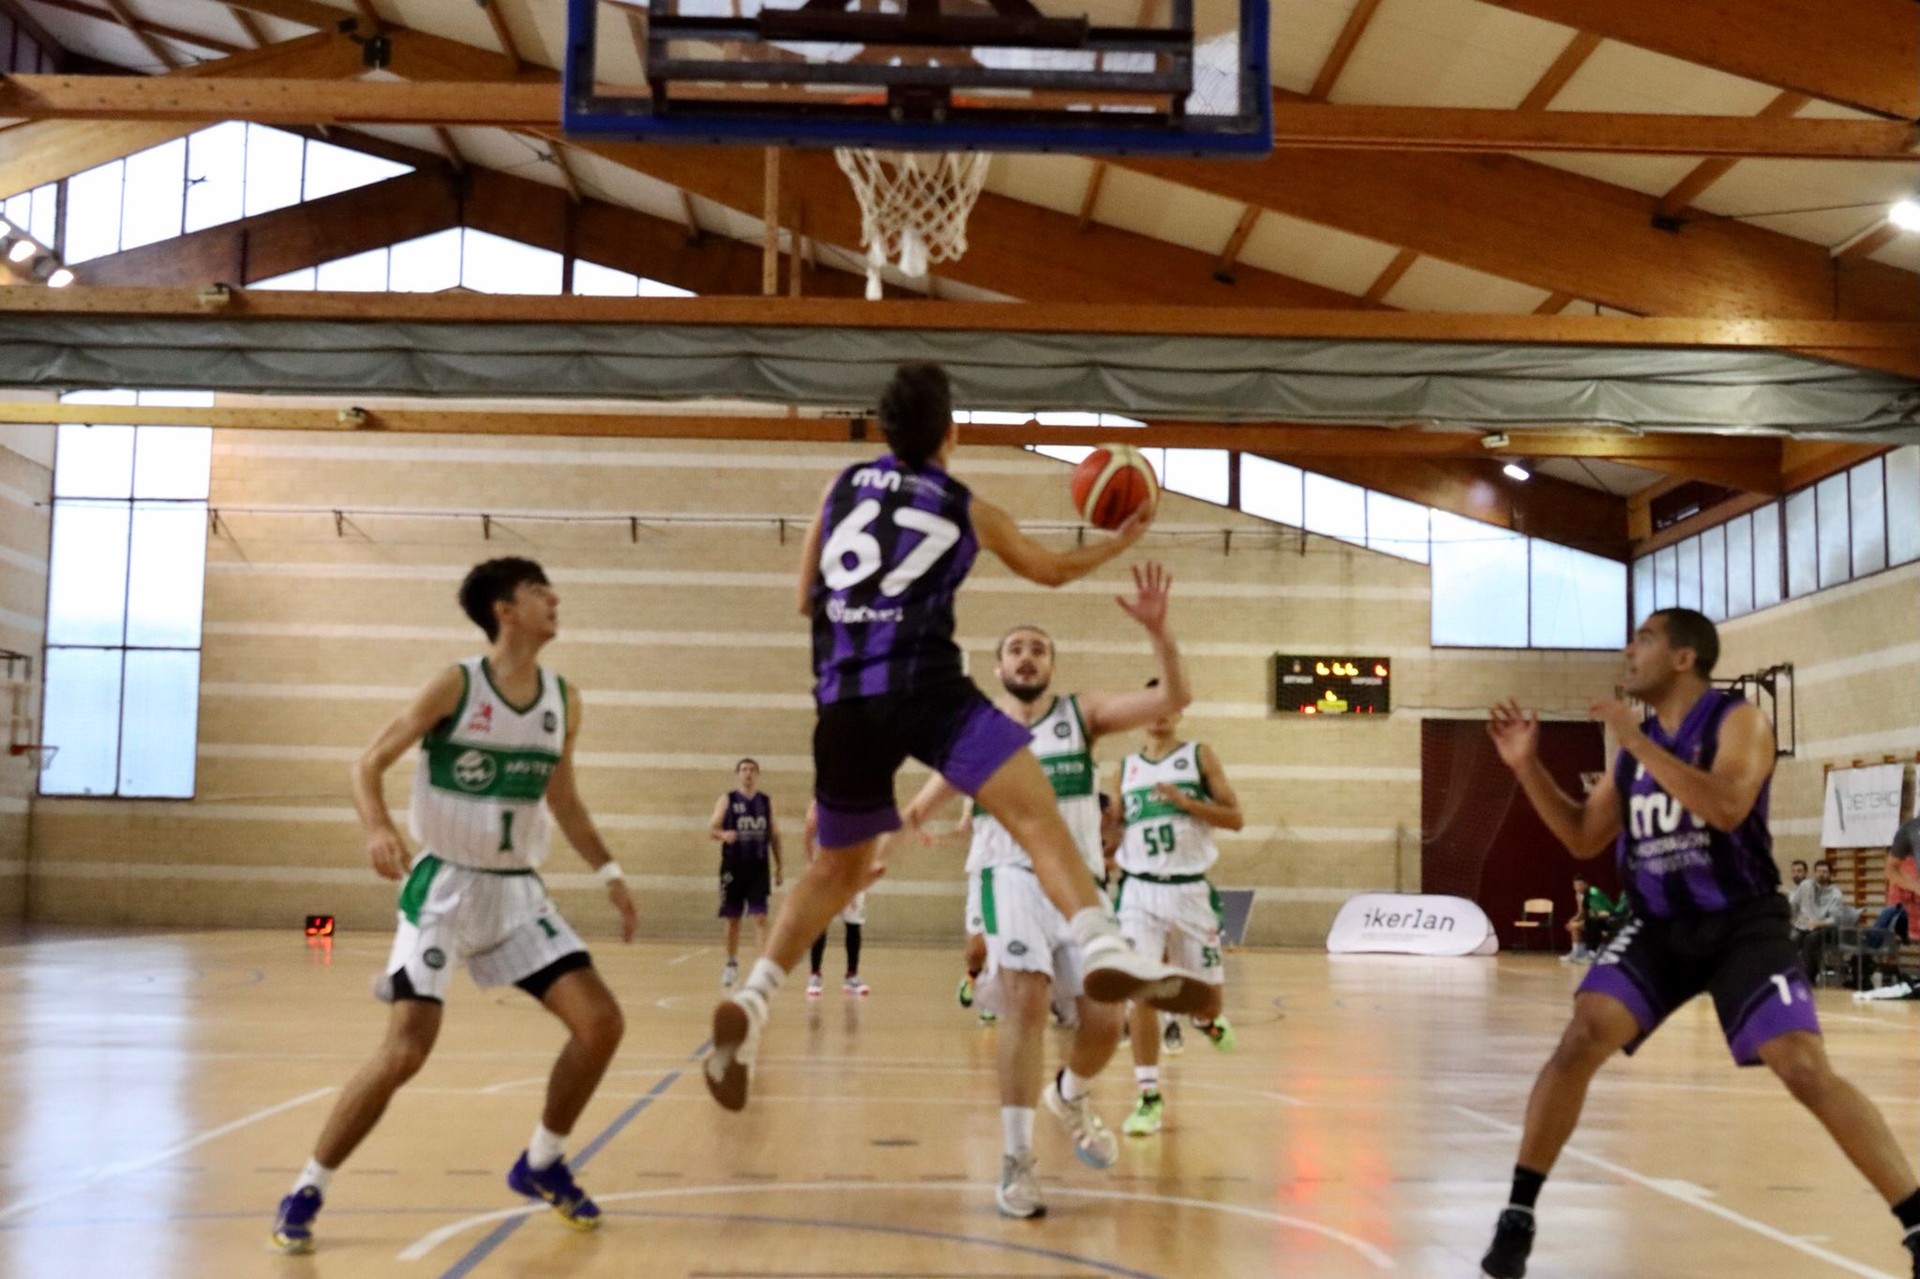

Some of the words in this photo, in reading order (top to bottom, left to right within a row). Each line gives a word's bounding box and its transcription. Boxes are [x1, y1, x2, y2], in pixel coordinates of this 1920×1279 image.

[819, 498, 960, 598] 67
[498, 810, 515, 852] 1
[1143, 823, 1176, 857] 59
[1363, 907, 1456, 932] ikerlan
